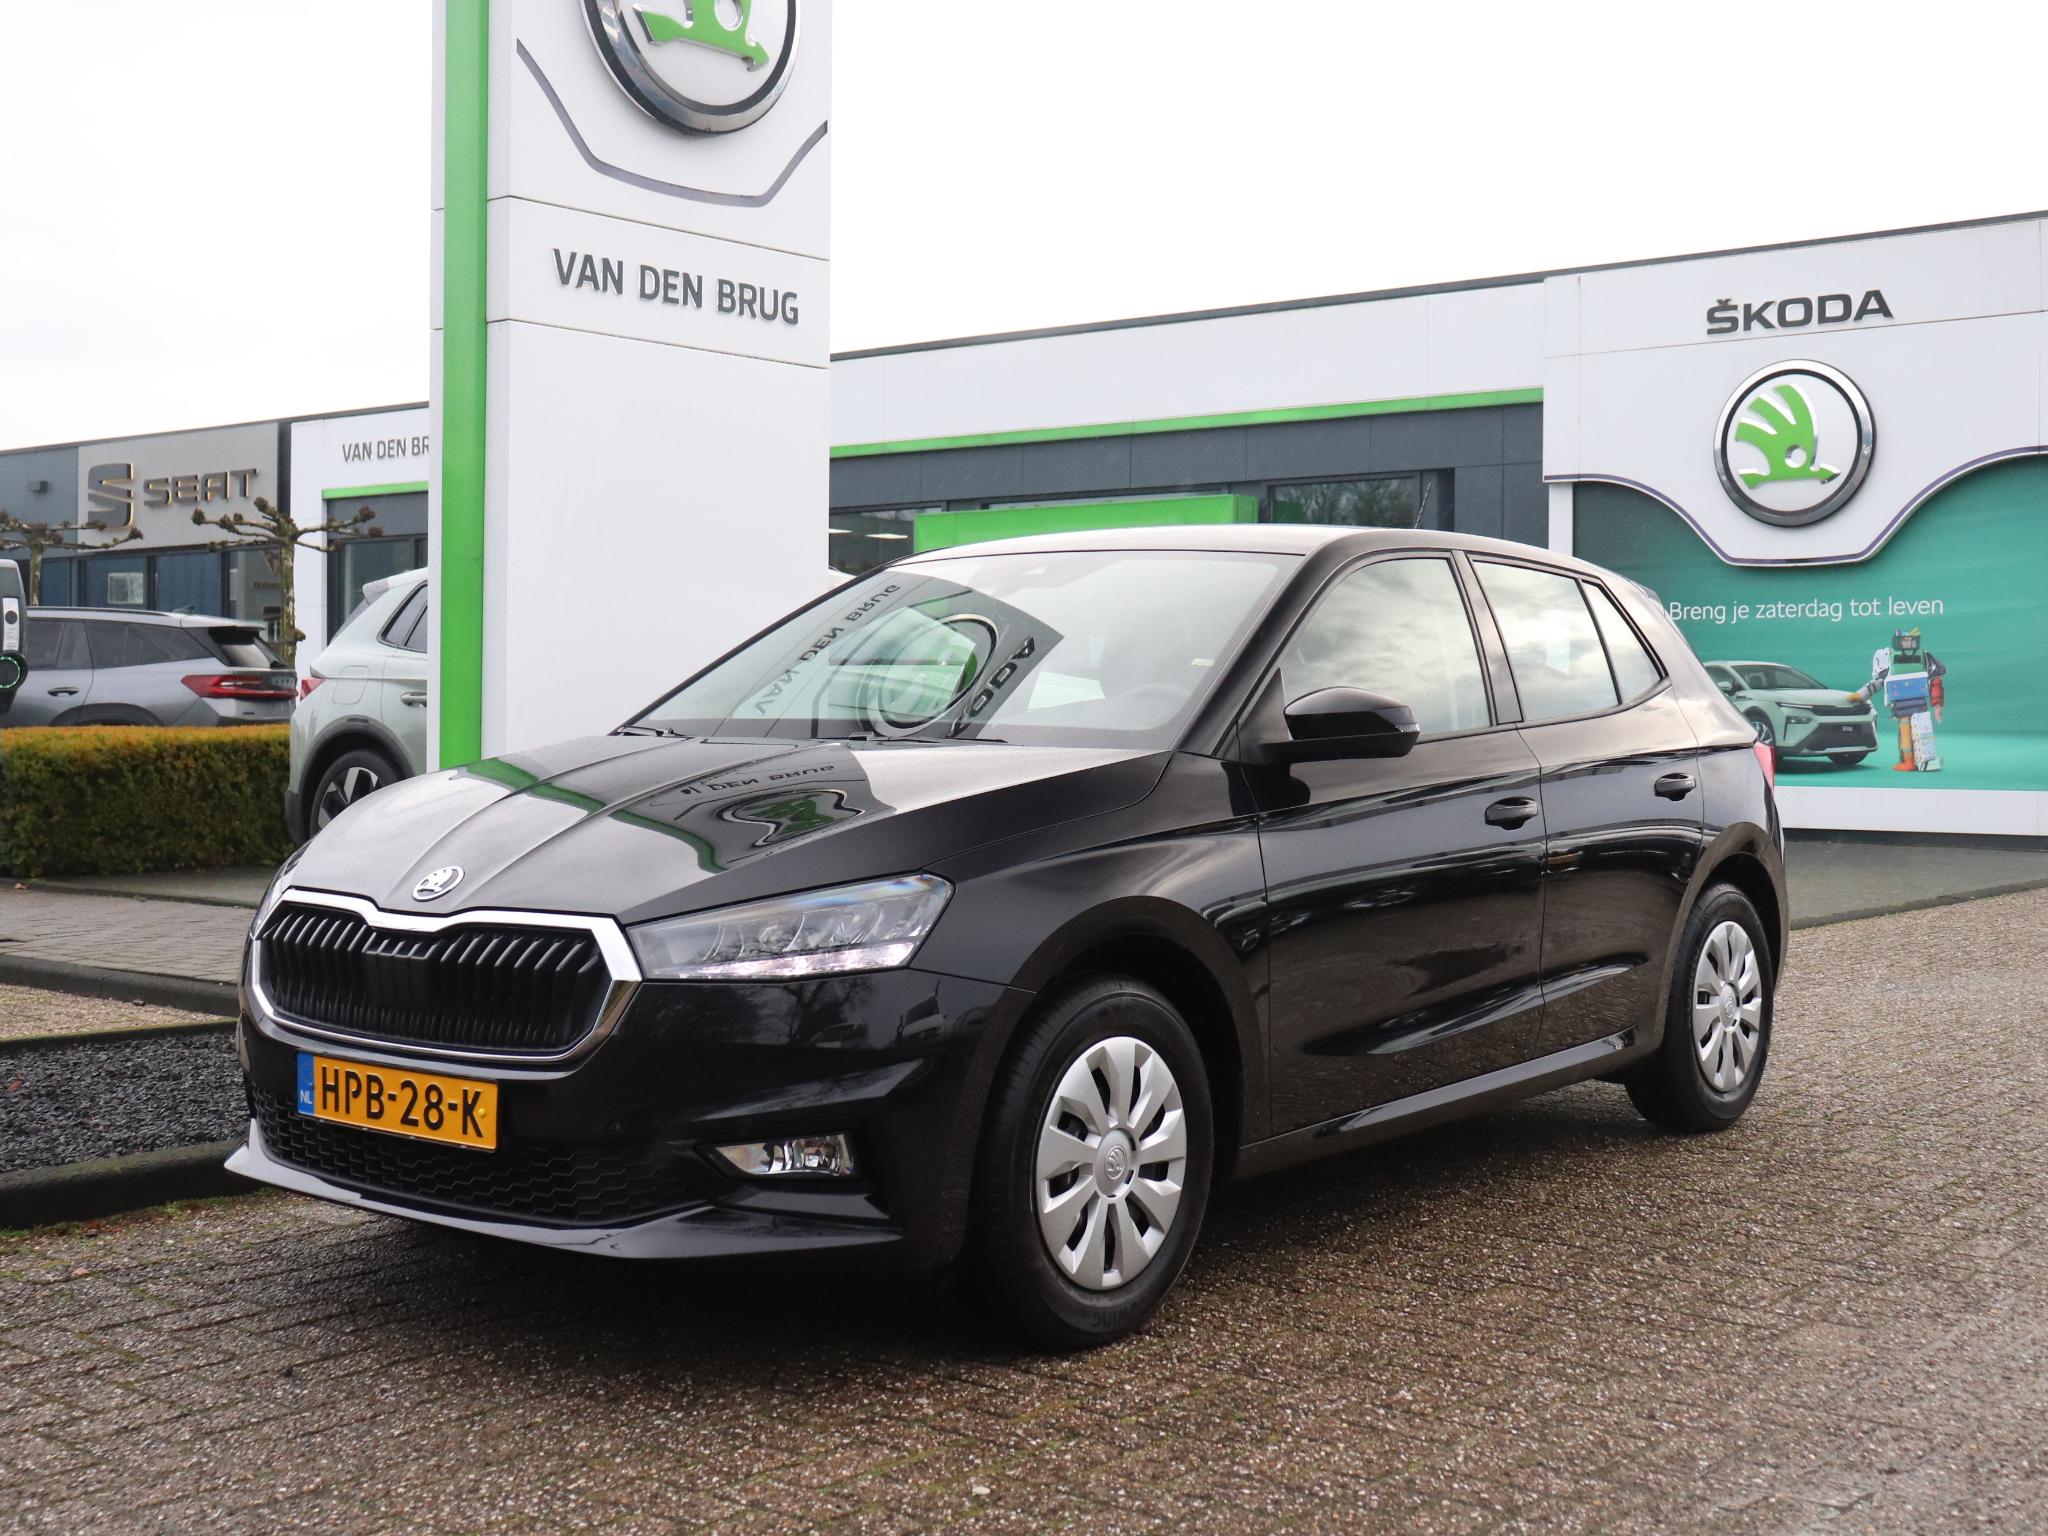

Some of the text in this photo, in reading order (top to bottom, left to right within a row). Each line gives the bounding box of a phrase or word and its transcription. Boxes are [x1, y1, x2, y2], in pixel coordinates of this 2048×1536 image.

[552, 247, 799, 325] VAN DEN BRUG
[1706, 289, 1894, 335] ŠKODA
[342, 435, 429, 463] VAN DEN BR
[143, 468, 258, 506] SEAT
[1668, 596, 1945, 624] Breng je zaterdag tot leven
[300, 1089, 313, 1105] NL
[321, 1065, 484, 1138] HPB-28-K
